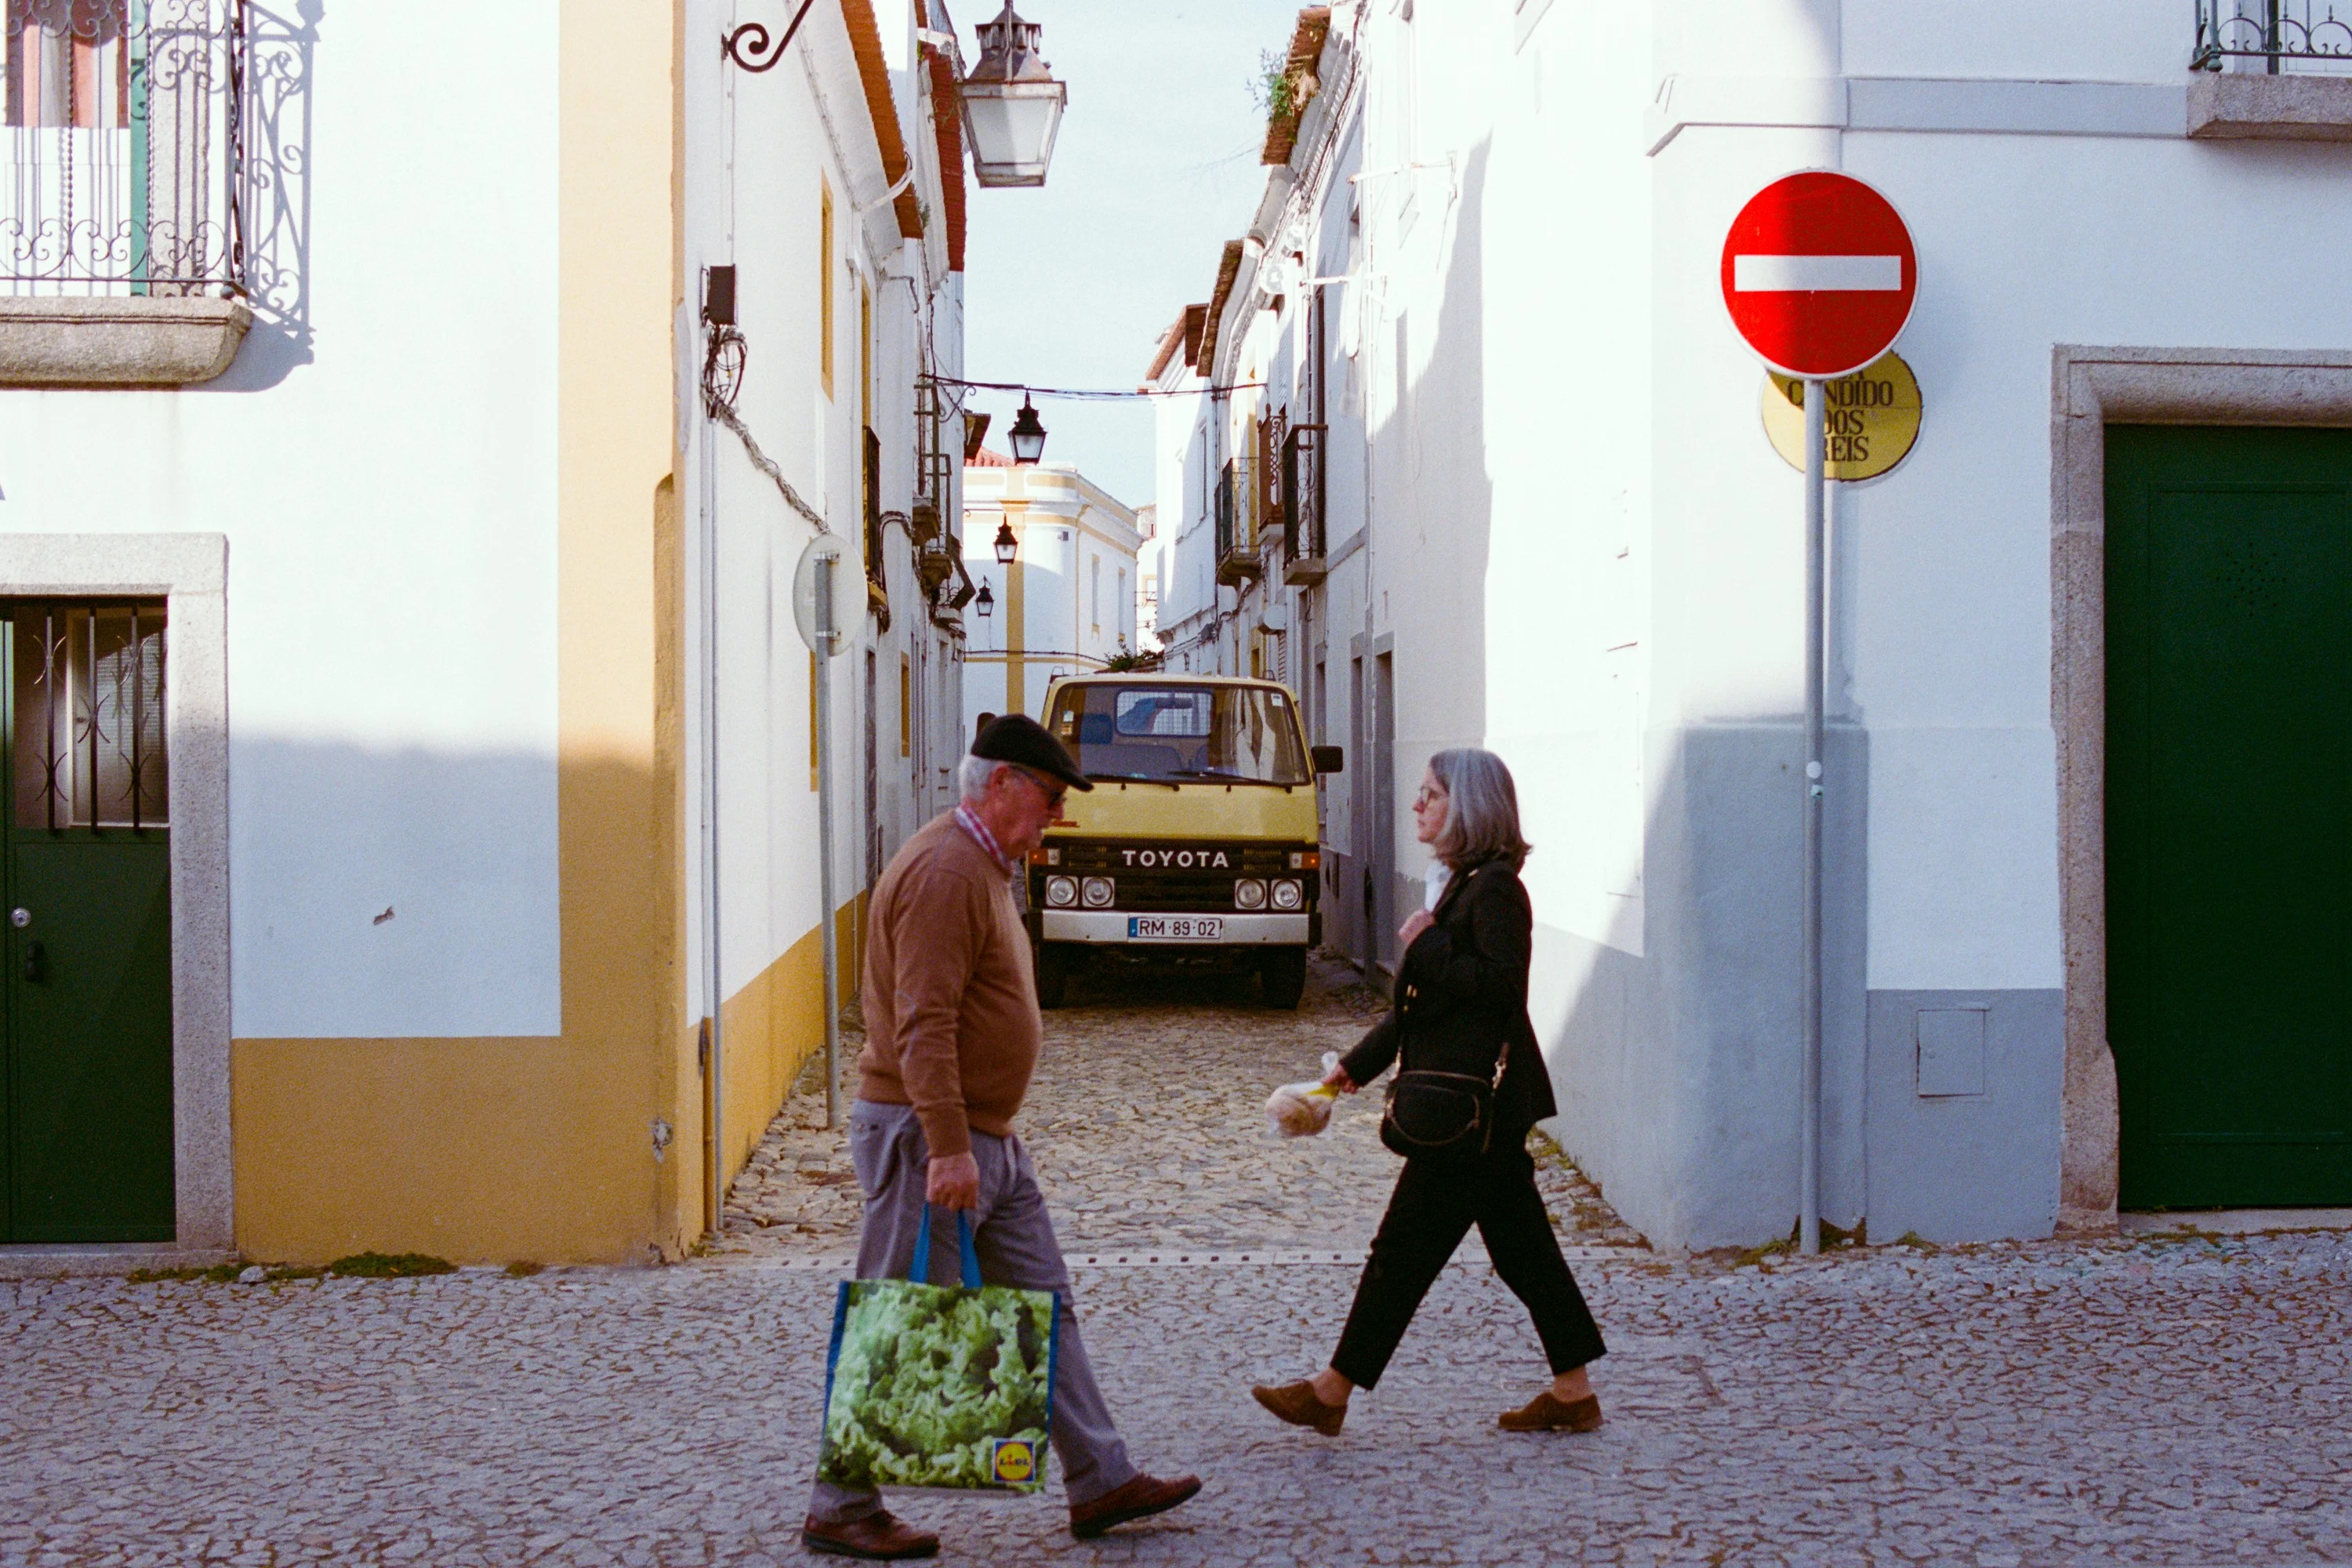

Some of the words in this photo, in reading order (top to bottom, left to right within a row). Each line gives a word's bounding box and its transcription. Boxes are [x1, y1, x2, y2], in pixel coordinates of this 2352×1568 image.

[1787, 380, 1893, 406] CNDIDO
[1824, 436, 1869, 461] EIS
[1122, 850, 1229, 868] TOYOTA
